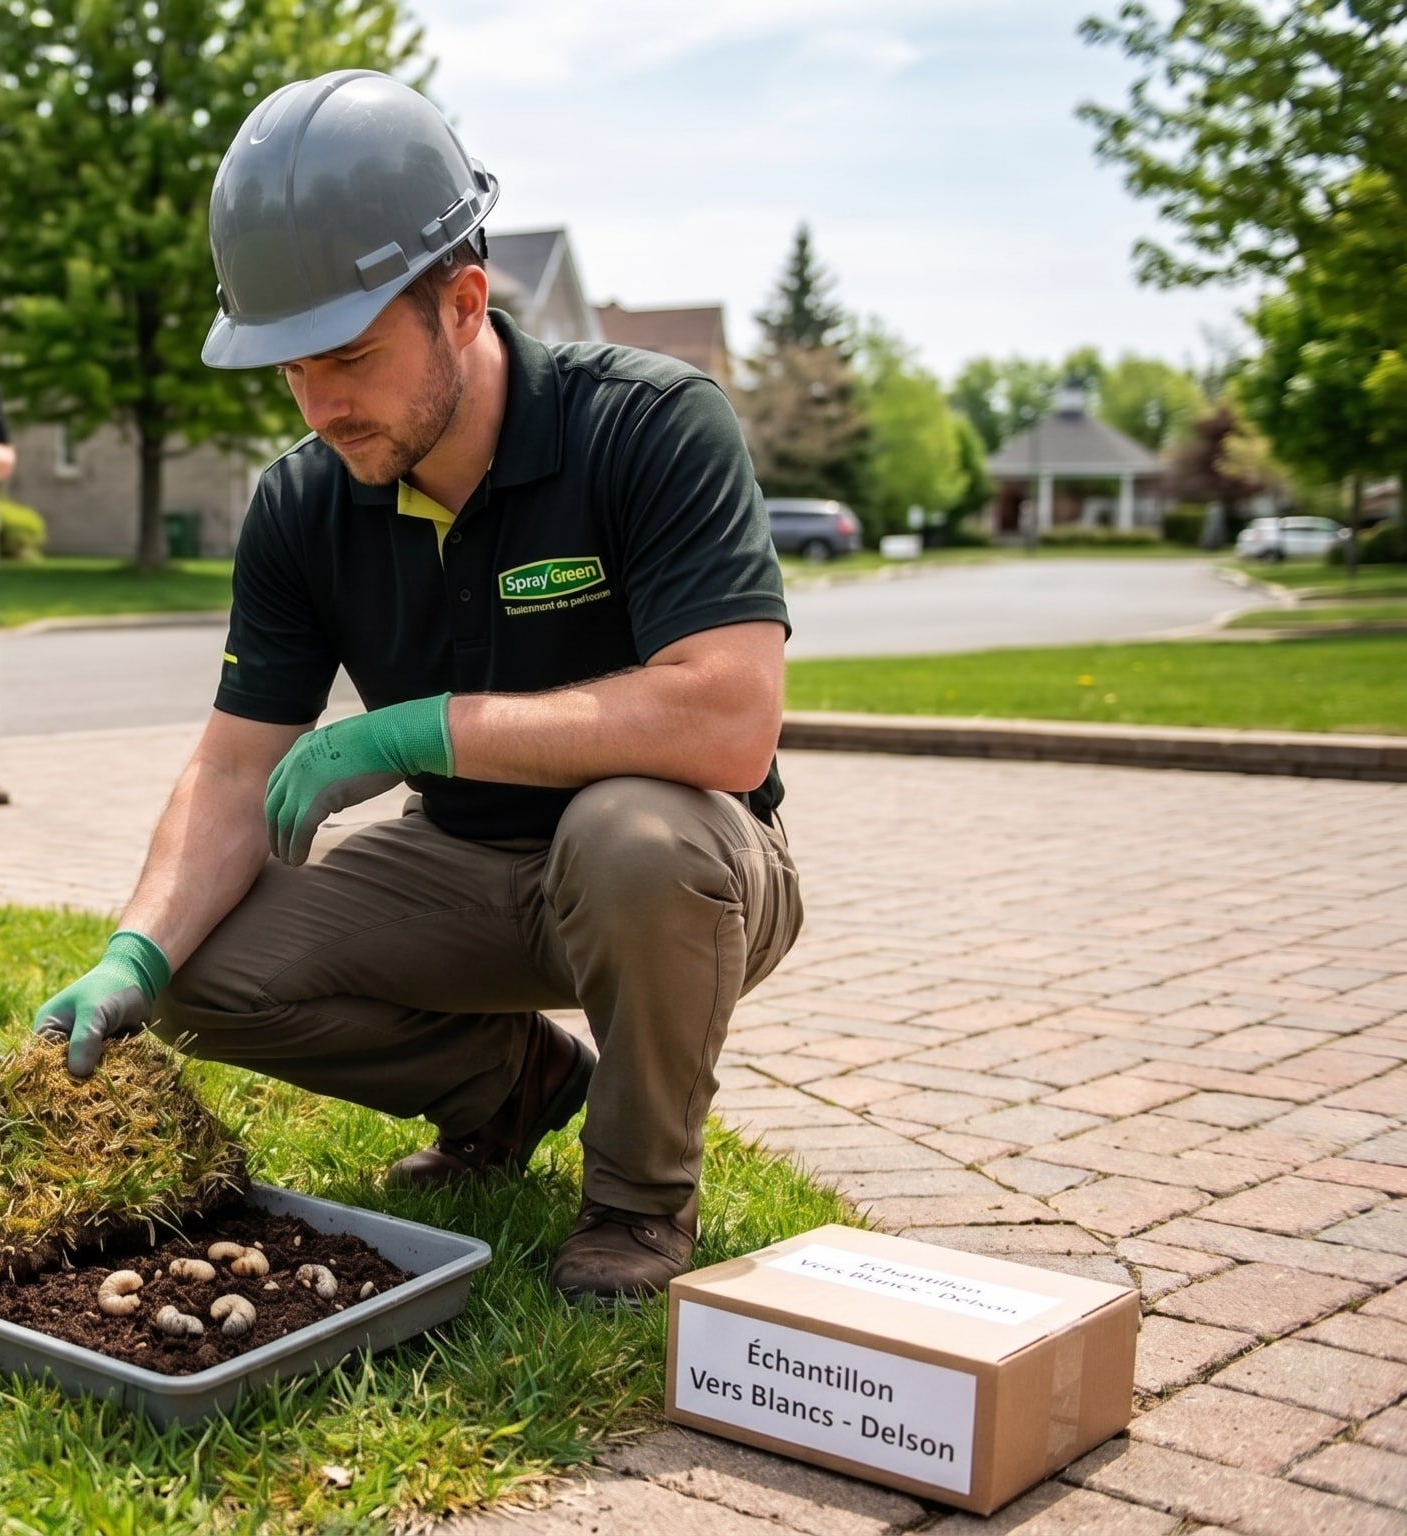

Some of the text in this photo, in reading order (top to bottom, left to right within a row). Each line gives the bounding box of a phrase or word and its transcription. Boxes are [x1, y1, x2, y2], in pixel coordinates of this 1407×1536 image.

[505, 565, 597, 593] Spray Green
[801, 1259, 846, 1275] Vers
[849, 1271, 919, 1292] Blancs
[748, 1339, 894, 1403] Échantillon
[690, 1367, 742, 1401] Vers
[751, 1384, 834, 1427] Blancs
[860, 1414, 955, 1462] Delson
